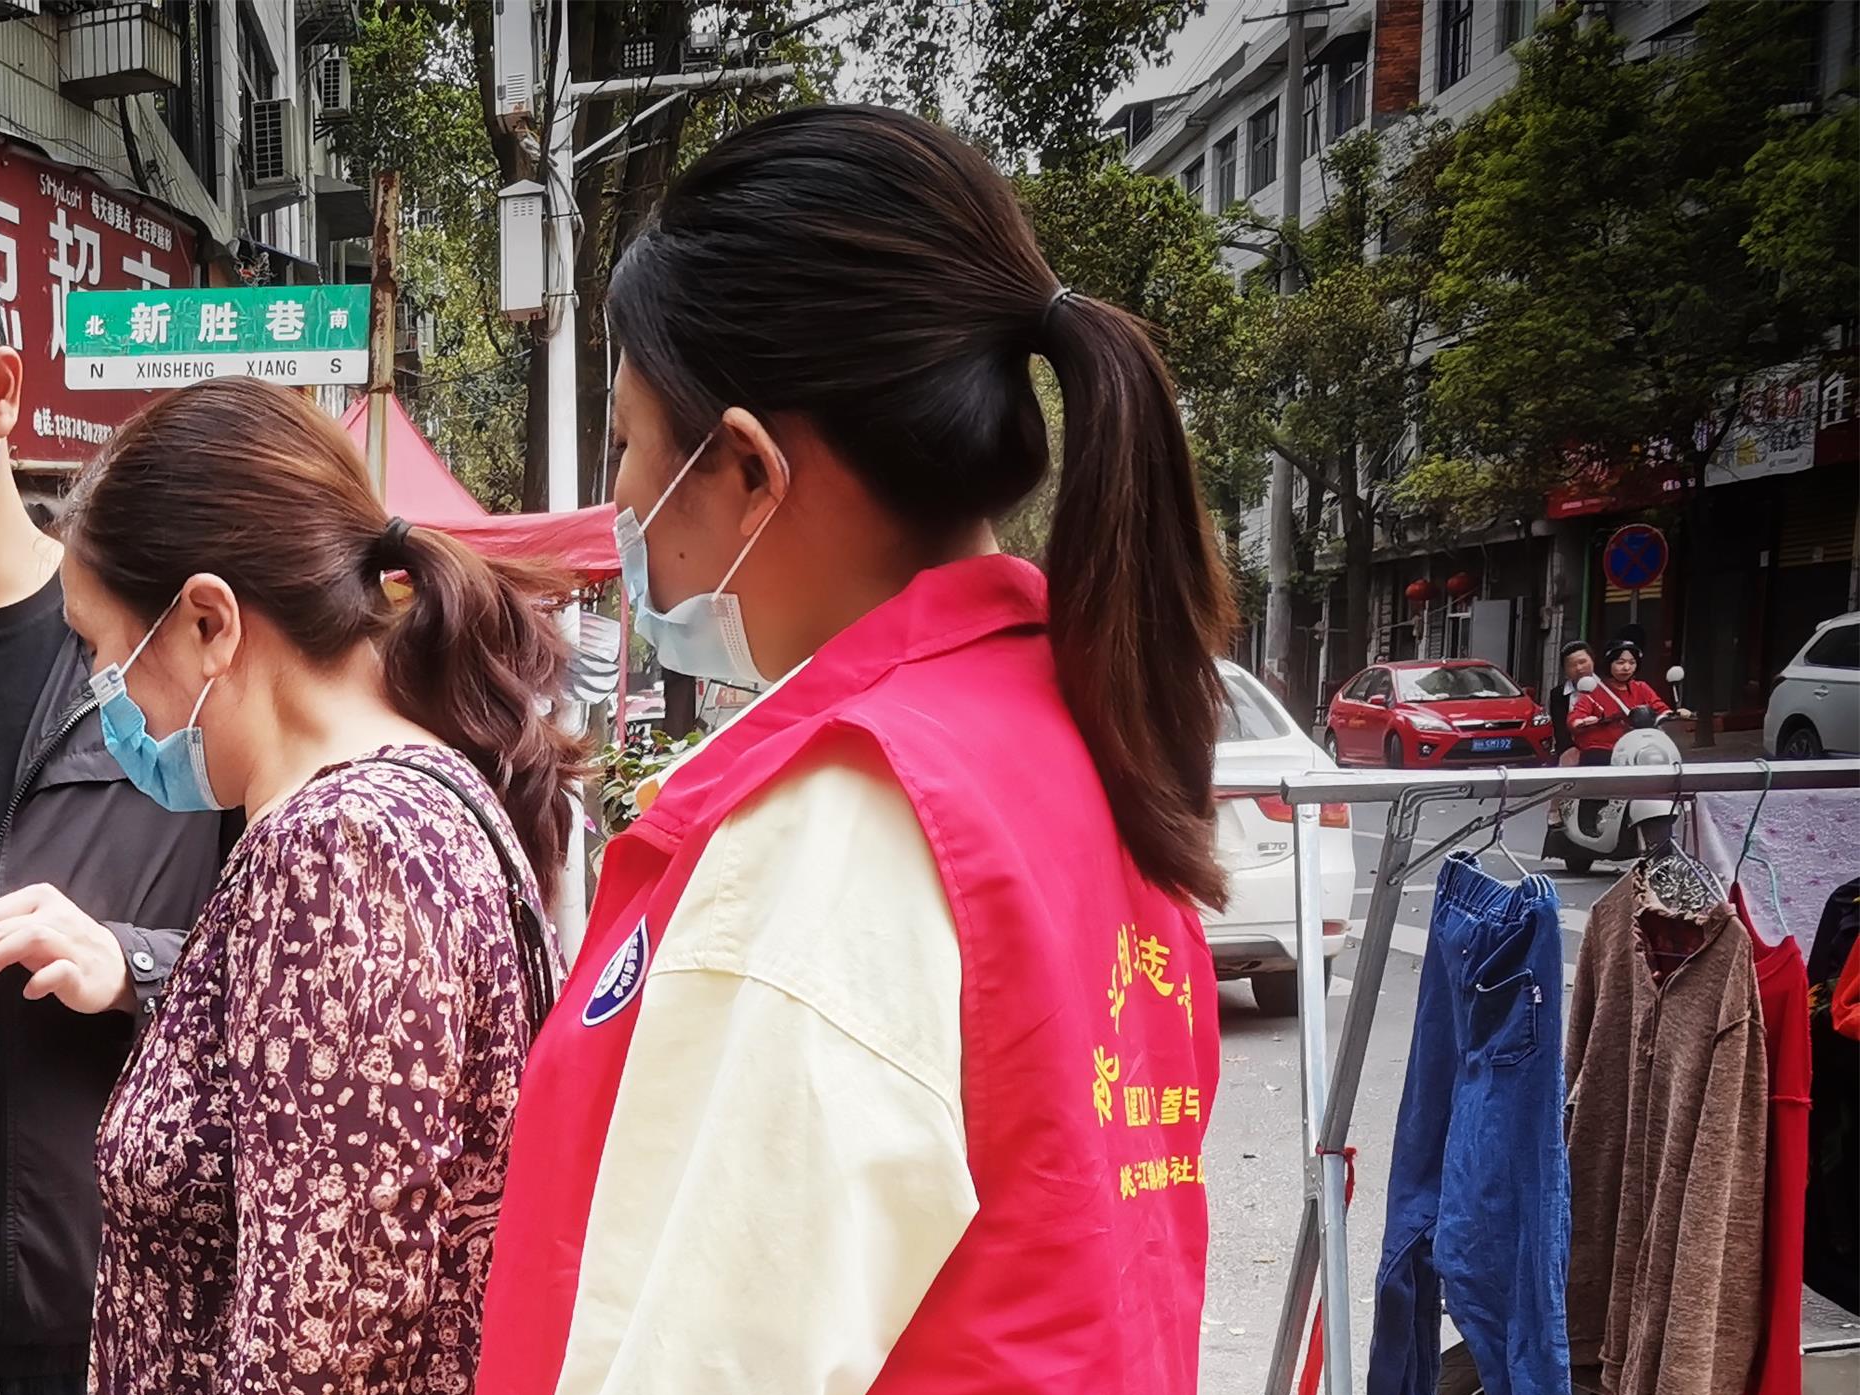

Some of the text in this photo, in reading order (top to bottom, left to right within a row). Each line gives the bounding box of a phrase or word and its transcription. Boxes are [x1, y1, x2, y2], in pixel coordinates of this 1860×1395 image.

[129, 301, 306, 345] 新胜巷
[327, 307, 348, 331] 南
[89, 356, 344, 380] N XINSHENG XIANG S
